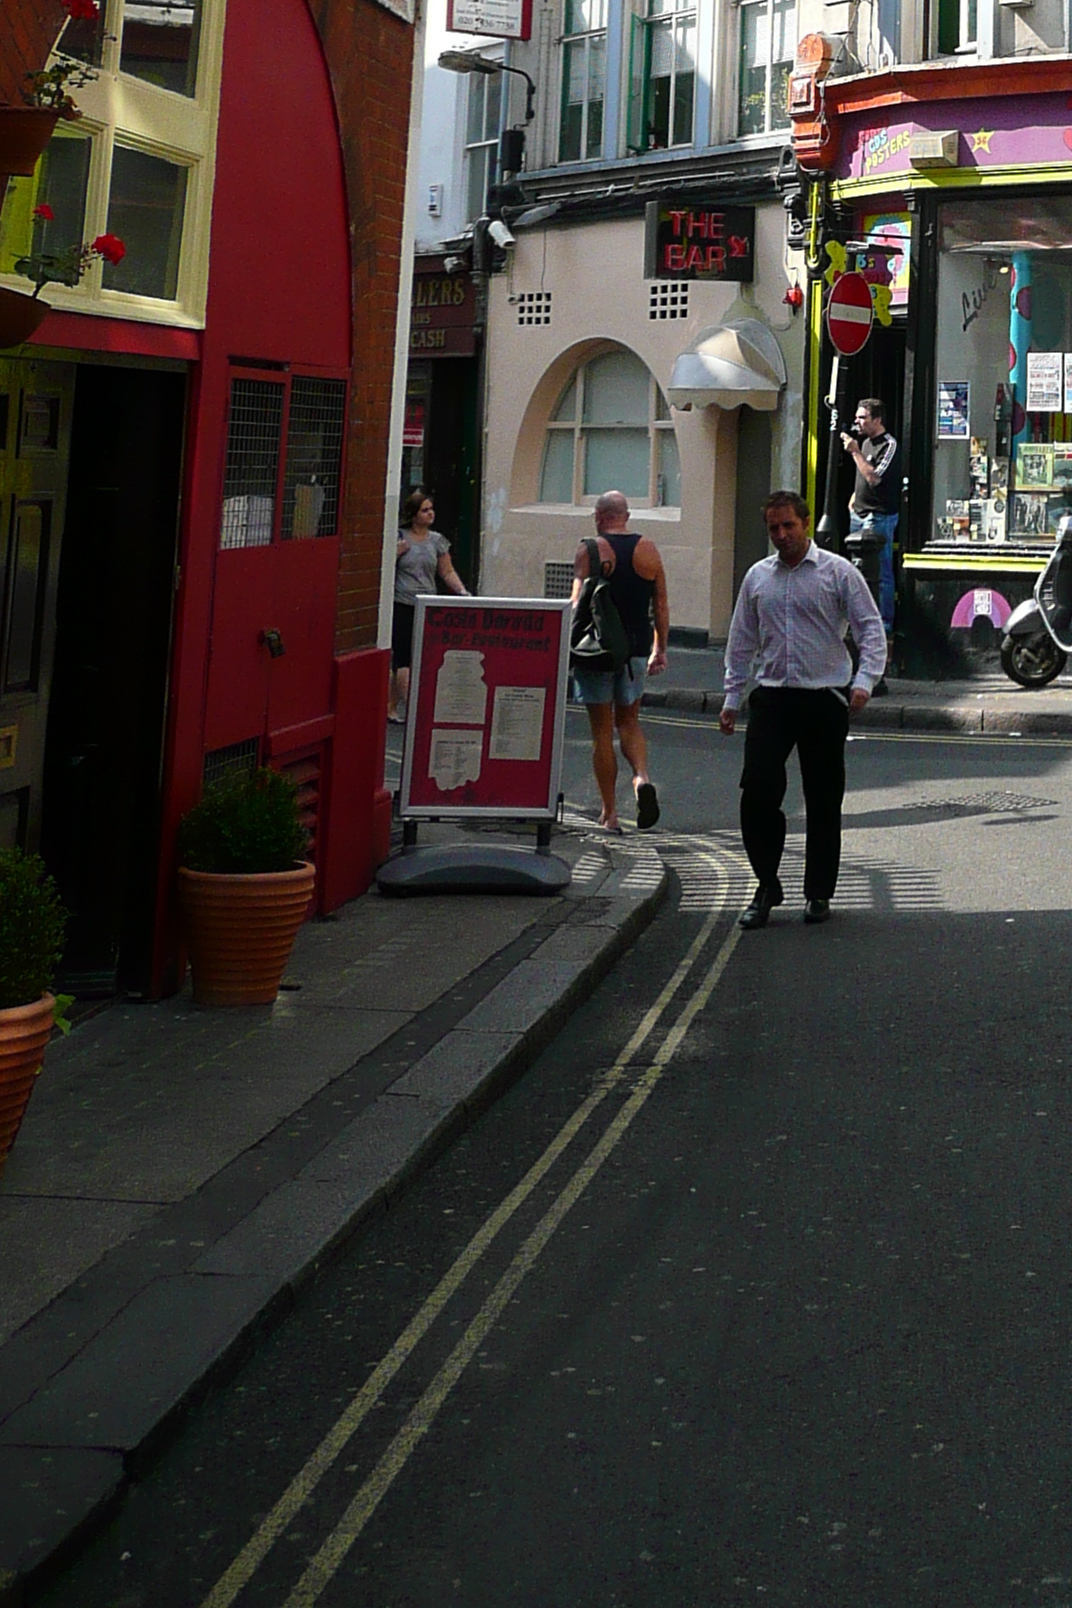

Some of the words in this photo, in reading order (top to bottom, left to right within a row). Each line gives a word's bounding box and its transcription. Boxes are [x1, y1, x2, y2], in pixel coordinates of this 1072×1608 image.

[865, 130, 911, 174] POSTERS
[668, 210, 727, 239] THE
[664, 243, 728, 273] BAR
[410, 329, 446, 348] CASH
